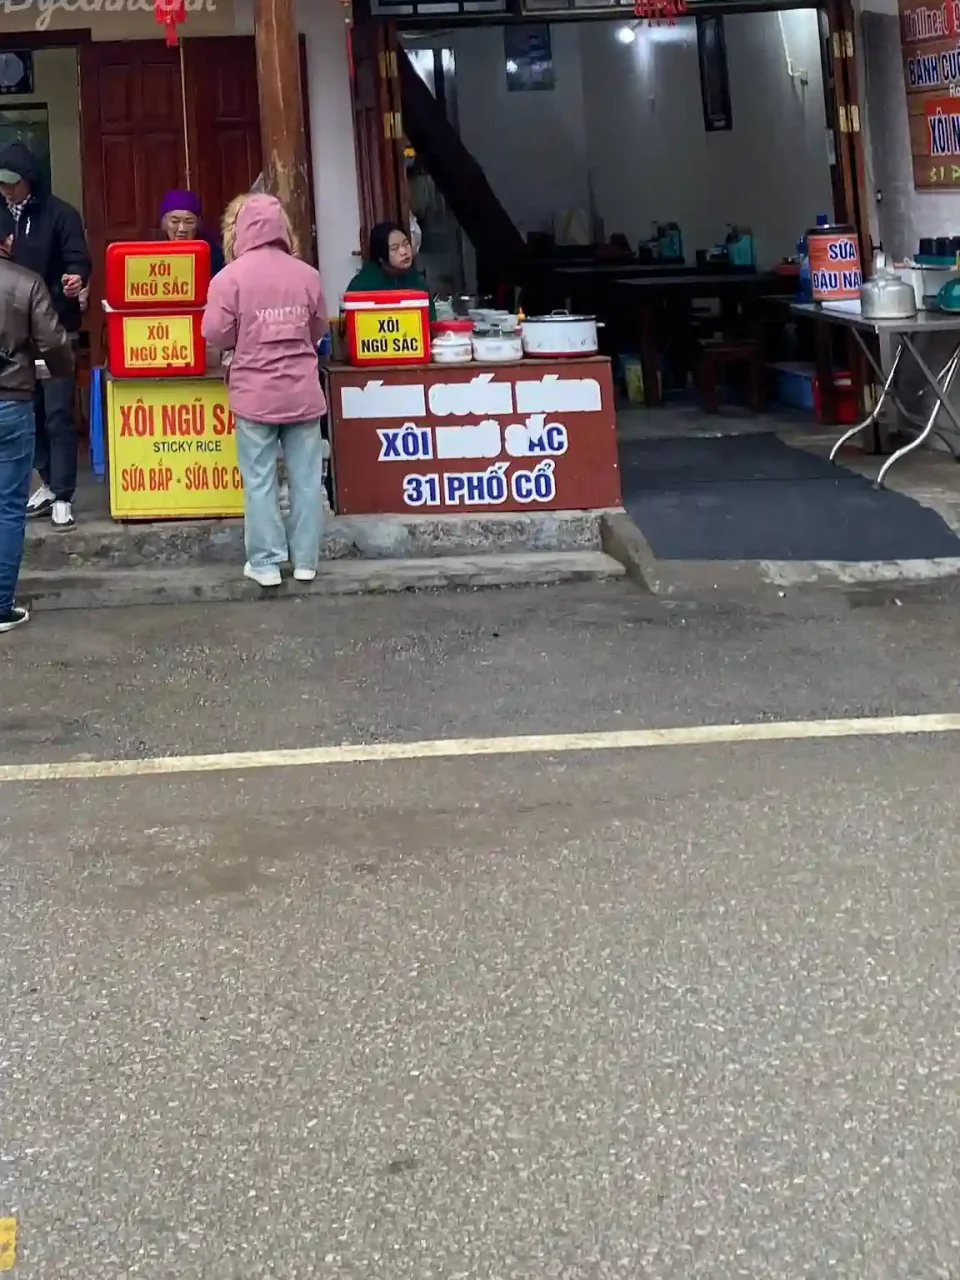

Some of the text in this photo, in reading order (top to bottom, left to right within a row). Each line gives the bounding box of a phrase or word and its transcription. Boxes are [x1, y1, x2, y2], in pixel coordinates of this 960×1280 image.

[148, 260, 171, 277] XÔI
[130, 276, 189, 296] NGŨ SẮC
[147, 321, 170, 340] XÔI
[378, 316, 399, 333] XÔI
[129, 340, 188, 361] NGŨ SẮC
[361, 331, 418, 352] NGŨ SẮC
[120, 397, 155, 437] XÔI
[162, 397, 205, 436] NGŨ
[153, 440, 222, 453] STICKY RICE
[382, 426, 429, 458] XÔI
[122, 463, 145, 491] SỮA
[149, 458, 172, 491] BẮP
[185, 462, 209, 490] SỮA
[406, 463, 552, 502] 31 PHỐ CỔ
